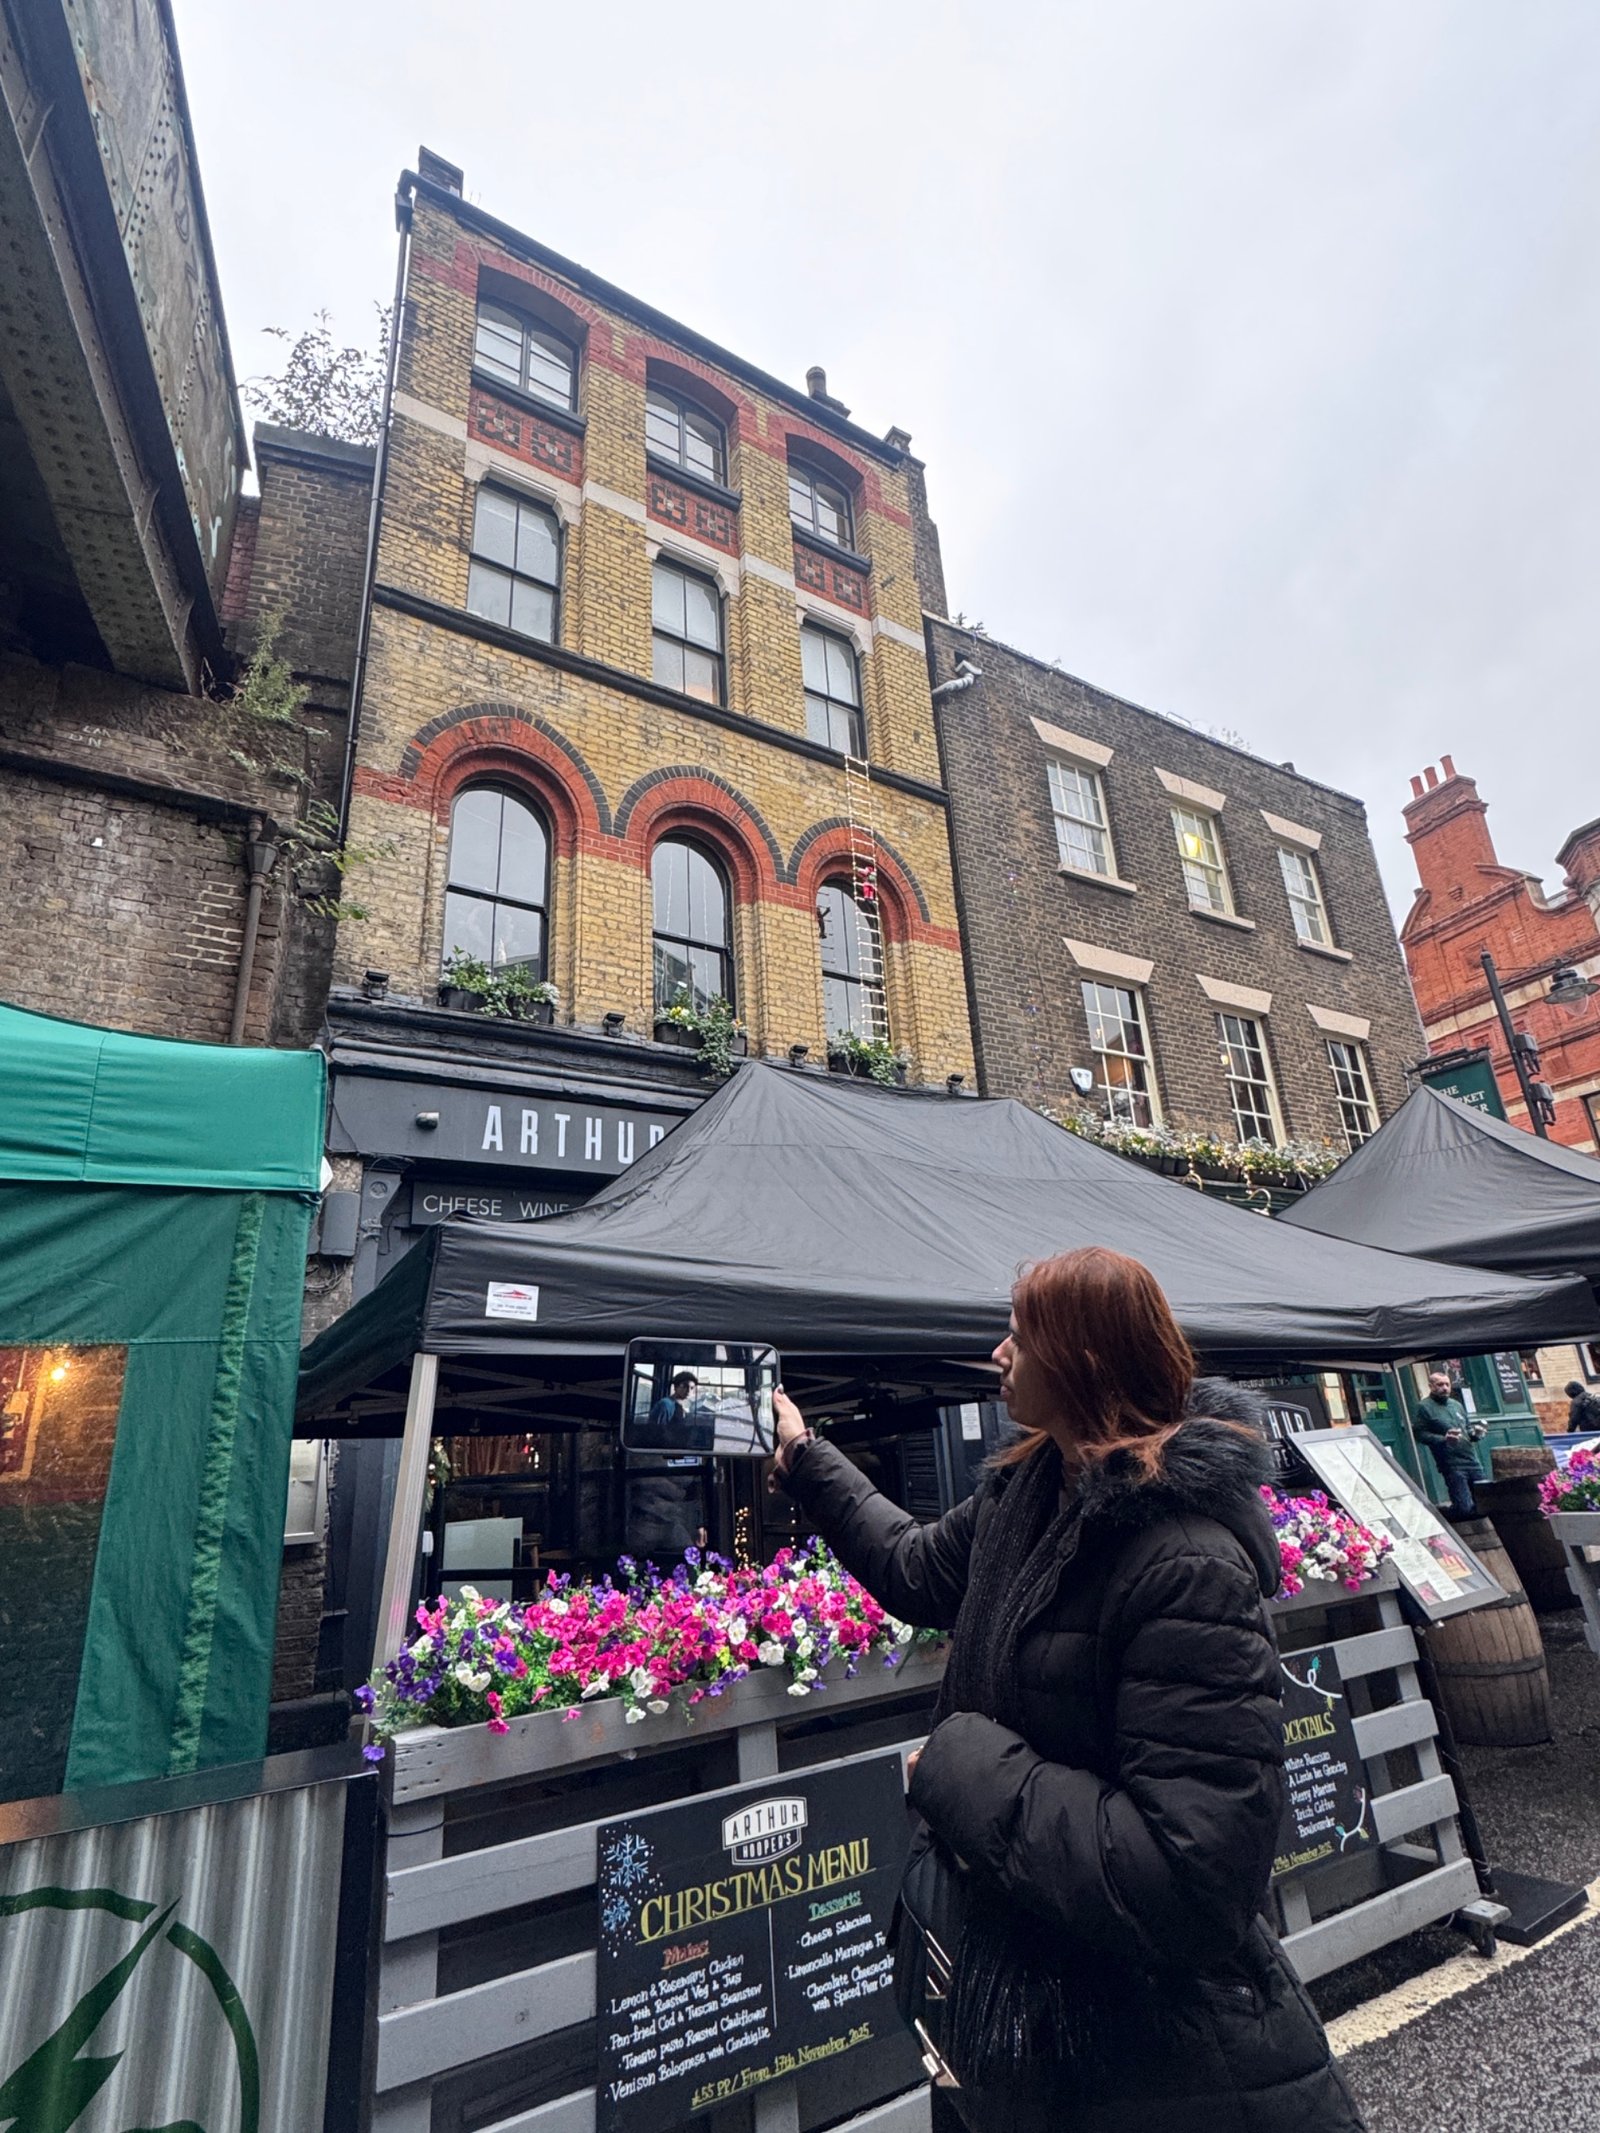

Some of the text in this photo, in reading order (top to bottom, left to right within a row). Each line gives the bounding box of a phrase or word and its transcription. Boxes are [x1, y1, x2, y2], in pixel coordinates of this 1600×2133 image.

[423, 1195, 502, 1217] CHEESE
[1283, 1711, 1336, 1744] OCKTAILS
[1288, 1775, 1296, 1788] A
[1291, 1789, 1312, 1805] Merry
[732, 1804, 799, 1840] ARTHUR
[1294, 1807, 1314, 1821] Irish
[742, 1832, 792, 1859] HOOPER'S
[640, 1838, 869, 1941] CHRISTMAS MENU
[808, 1890, 862, 1919] Desserts
[801, 1913, 872, 1947] Cheese Selection
[788, 1931, 886, 1979] Limoncello Meringue Fo
[611, 1954, 744, 2014] Lemon & Rosemary Chicken
[806, 1954, 895, 1998] Chocolate Cheesecak
[629, 1973, 742, 2023] with Roasted Veg & Jus
[812, 1996, 831, 2012] with
[833, 1983, 861, 2007] Spiced
[610, 1984, 762, 2051] Pan-fried Cod & Tuscan Beanstew
[622, 2006, 768, 2071] Tomato pesto Roasted Cauliflower
[741, 2066, 769, 2088] From
[774, 2053, 795, 2074] 17th
[848, 2022, 871, 2043] 2025
[609, 2026, 771, 2102] Venison Bolognese with Conchiglie
